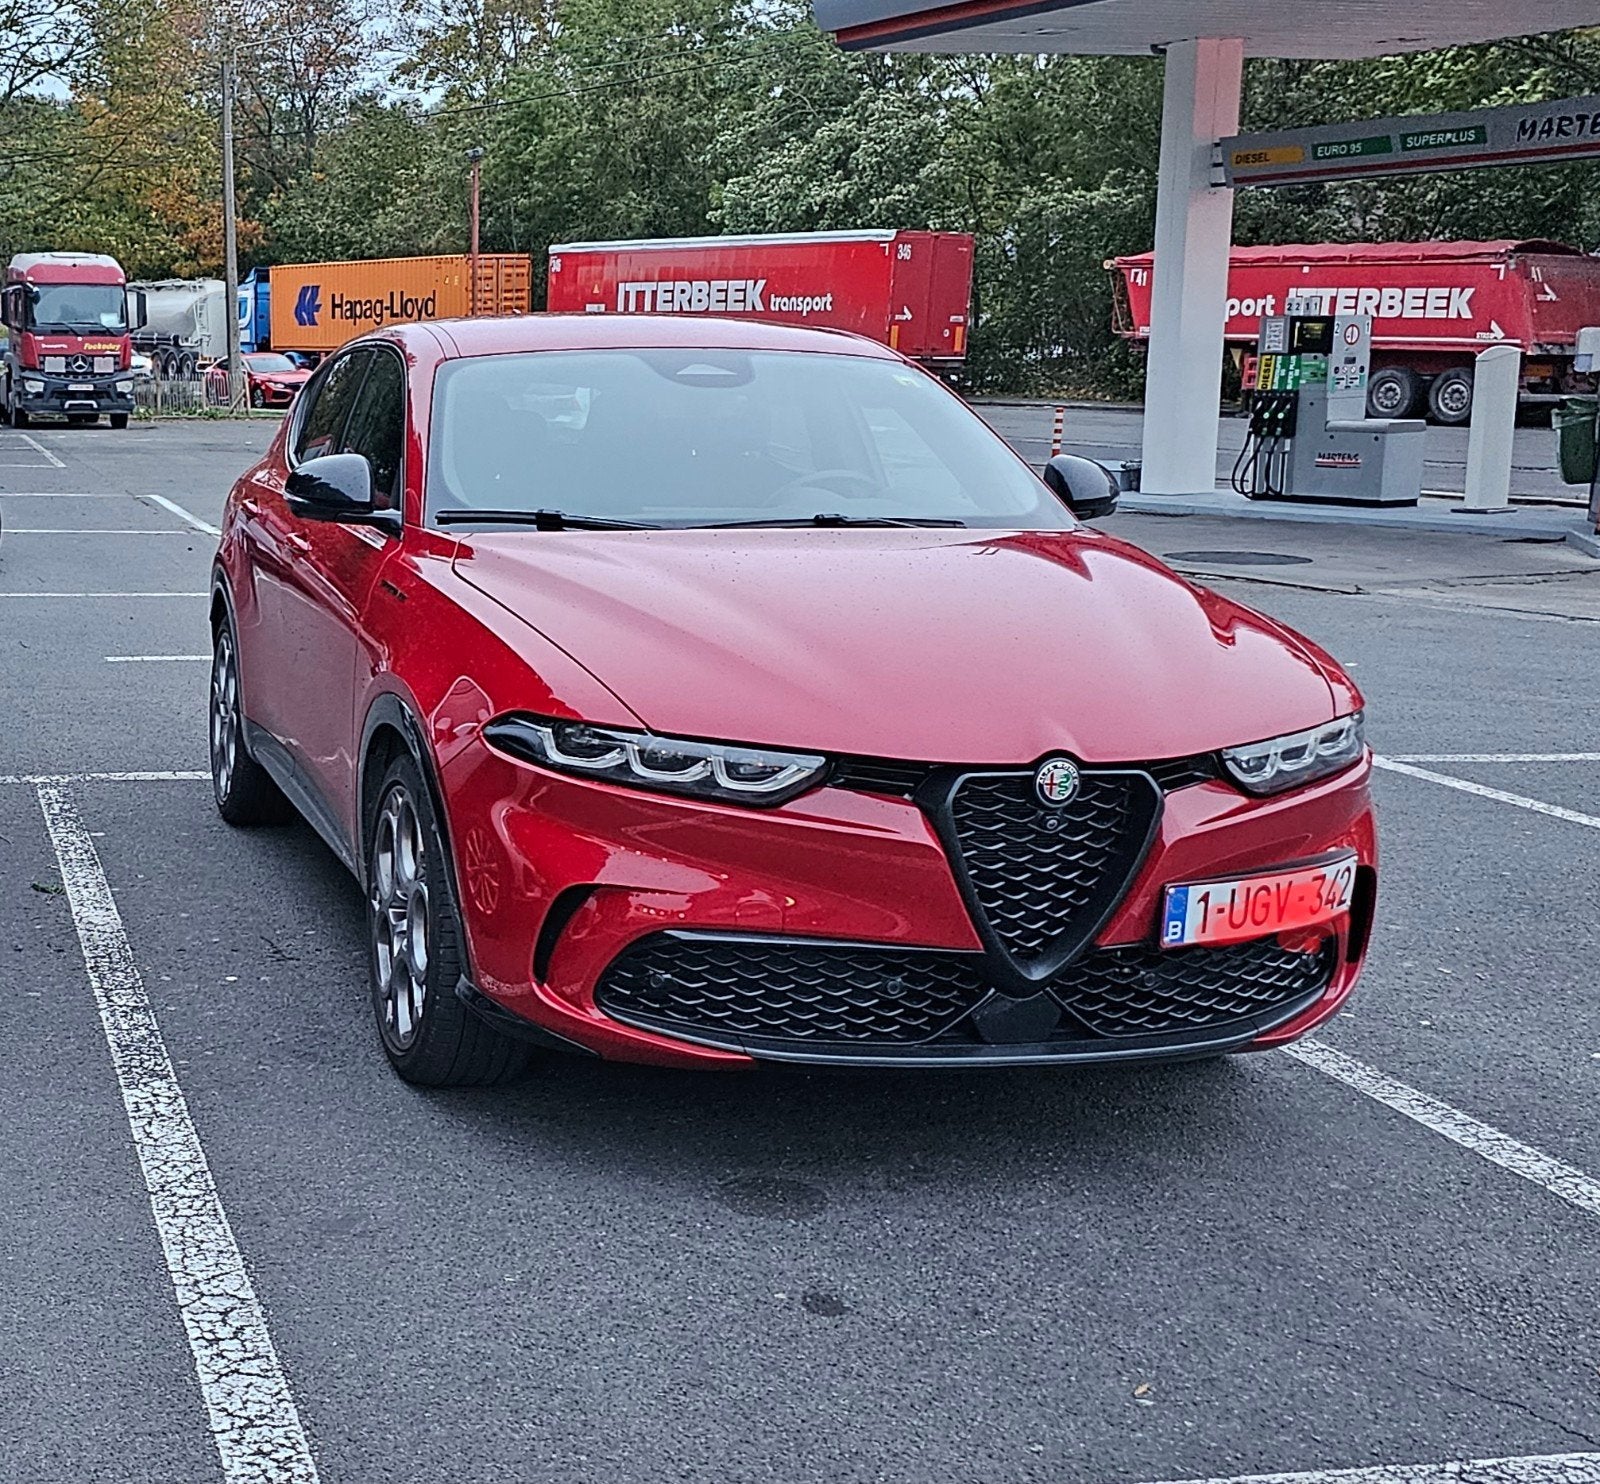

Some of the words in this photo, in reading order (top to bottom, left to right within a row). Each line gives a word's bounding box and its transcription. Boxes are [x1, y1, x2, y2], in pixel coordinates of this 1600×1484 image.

[1406, 129, 1476, 148] SUPERPLUS
[1235, 153, 1271, 165] DIESEL
[1317, 145, 1347, 157] EURO
[1350, 142, 1362, 153] 95
[897, 243, 912, 260] 346
[617, 279, 767, 312] ITTERBEEK
[770, 293, 833, 316] transport
[331, 289, 436, 326] Hapag-Lloyd
[1261, 357, 1272, 390] DIESEL
[1167, 921, 1182, 940] B
